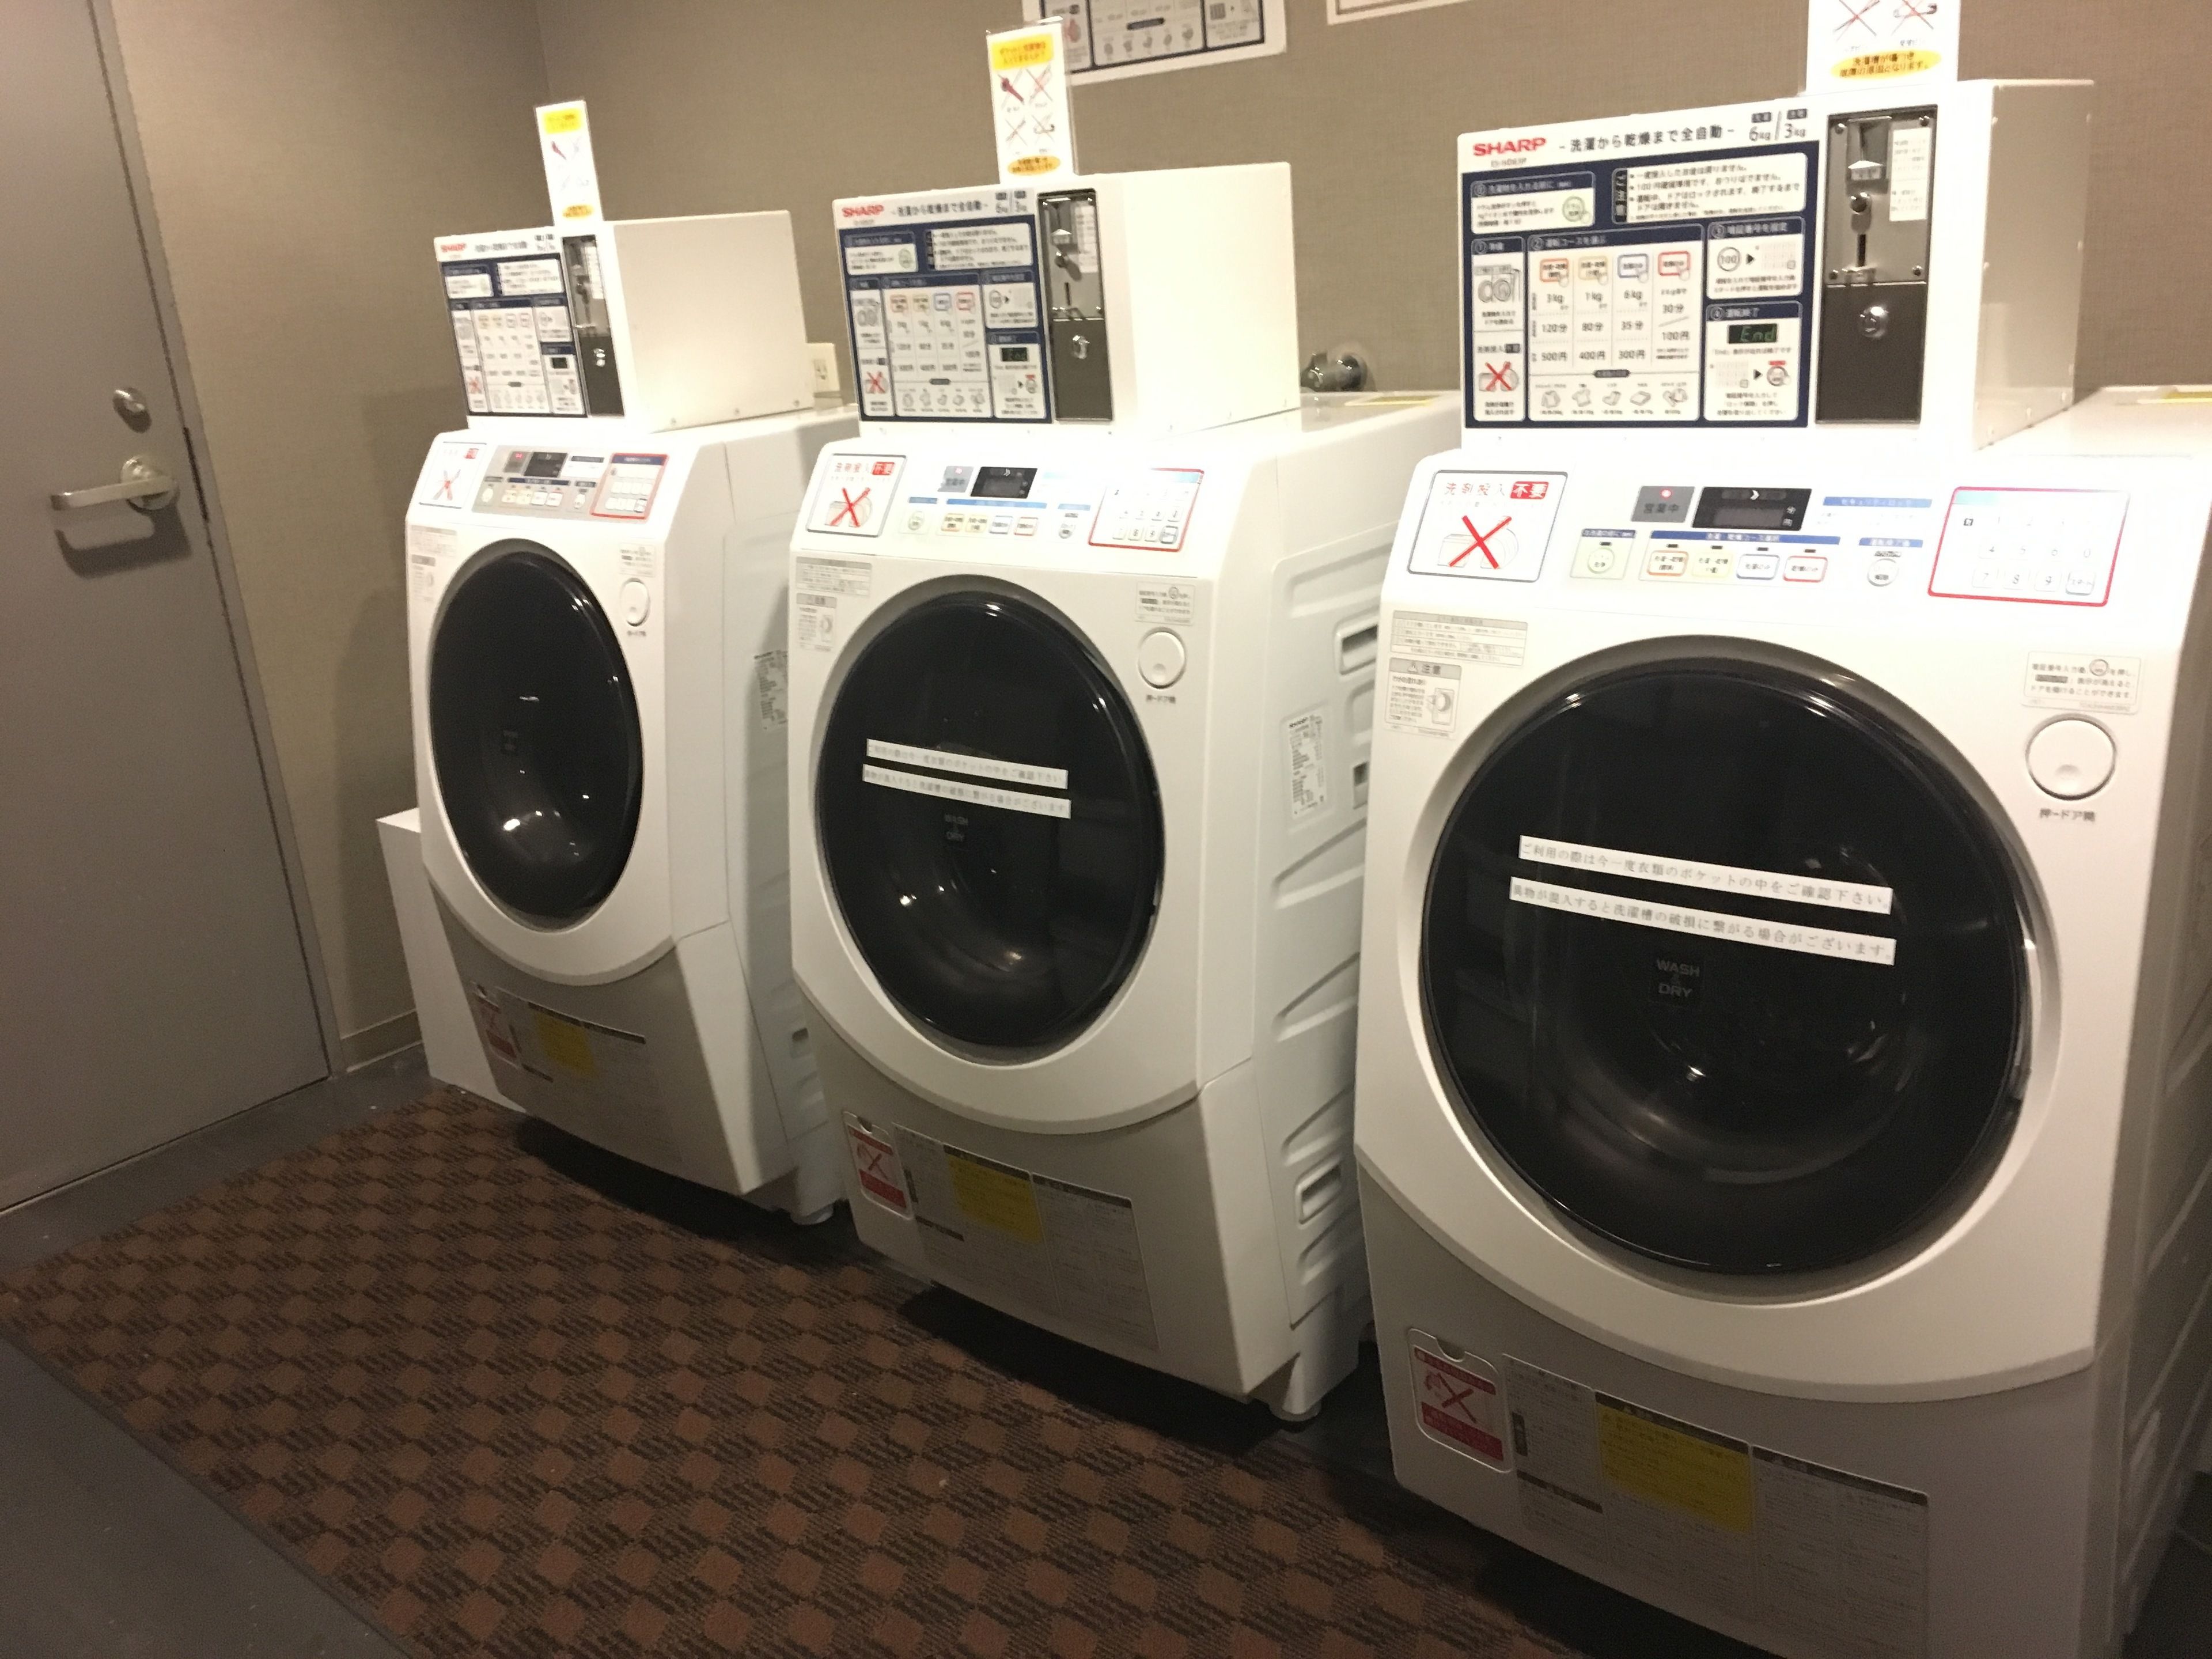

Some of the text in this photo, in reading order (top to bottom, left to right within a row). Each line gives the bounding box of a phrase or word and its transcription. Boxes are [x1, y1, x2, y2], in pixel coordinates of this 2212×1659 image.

[1473, 137, 1546, 156] SHARP
[842, 204, 884, 218] SHARP
[1513, 483, 1548, 498] 不要
[1656, 959, 1700, 977] WASH
[1658, 983, 1692, 998] DRY
